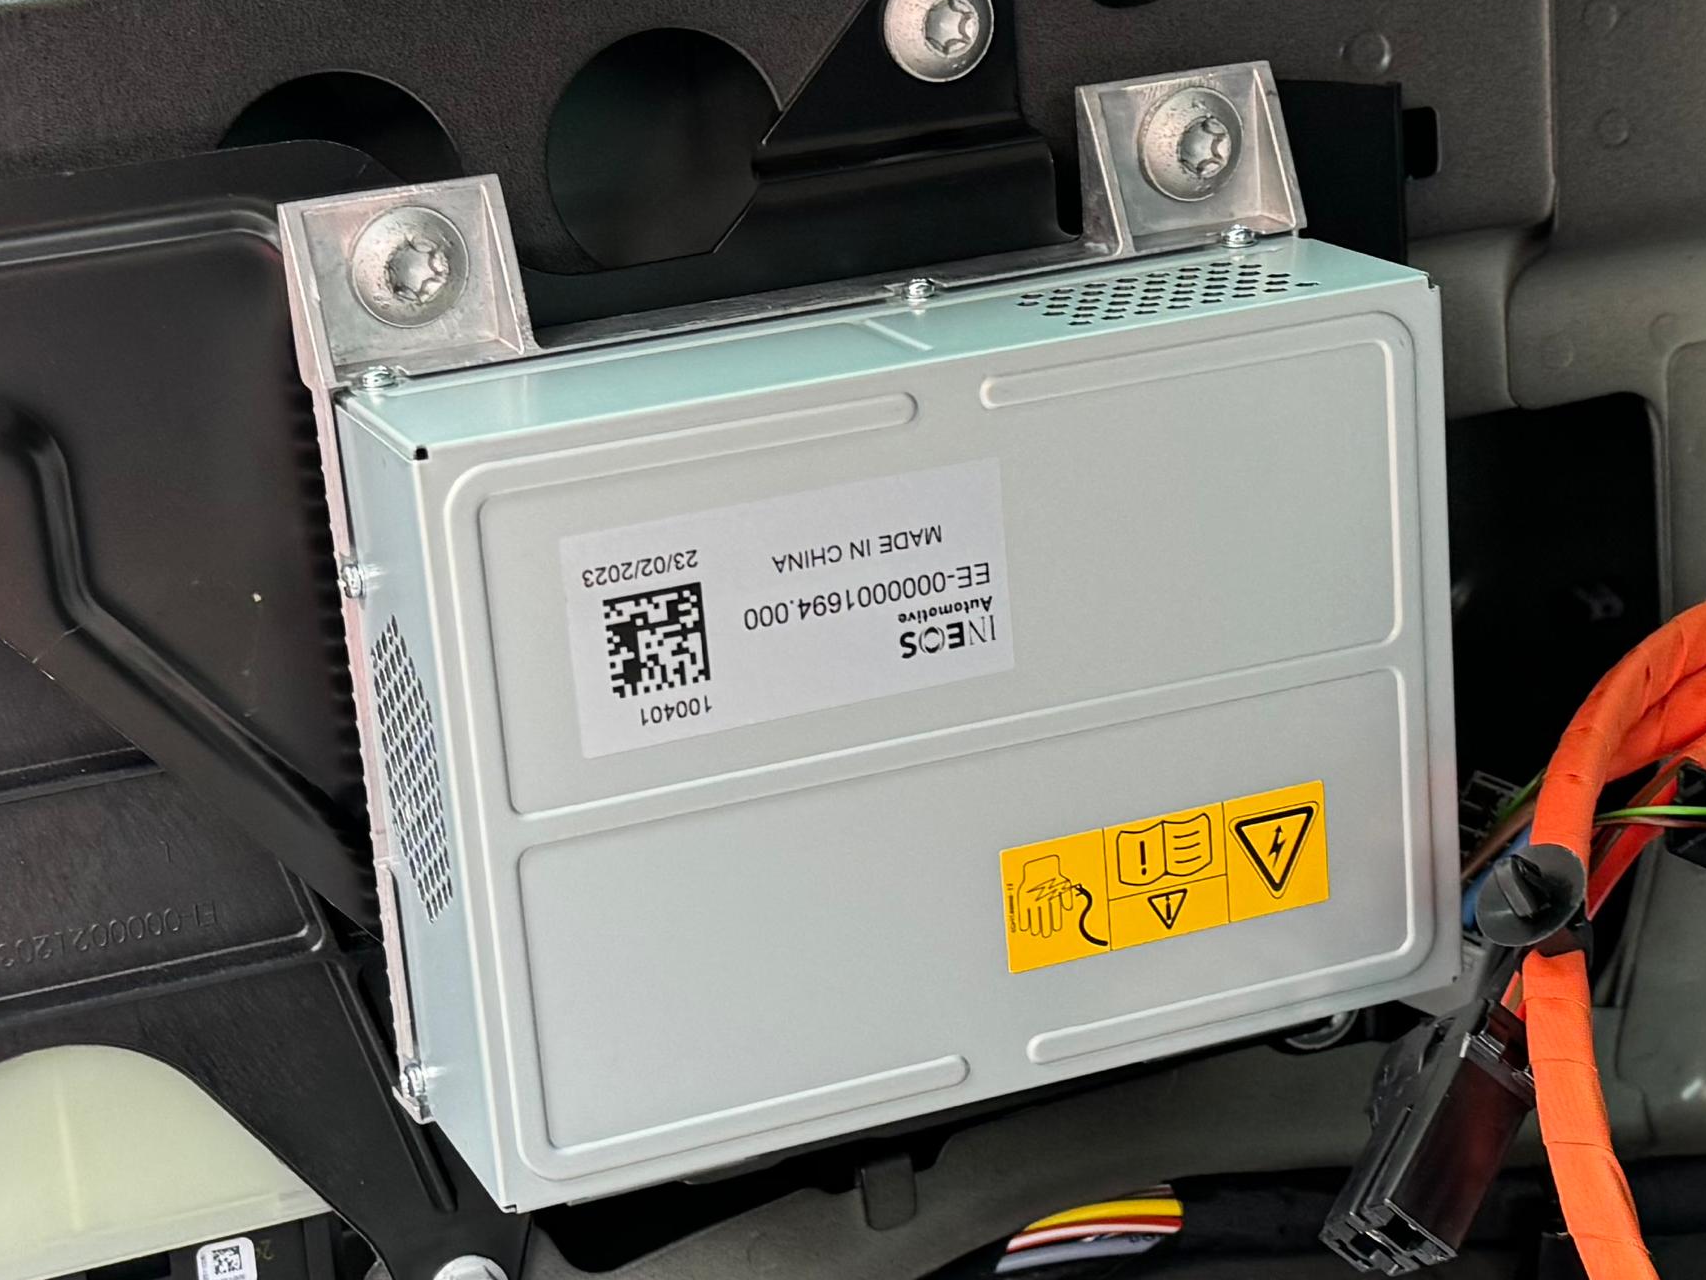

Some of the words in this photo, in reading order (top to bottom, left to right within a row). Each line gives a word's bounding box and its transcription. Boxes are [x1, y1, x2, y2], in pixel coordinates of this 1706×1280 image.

[849, 538, 870, 562] IN
[879, 524, 942, 554] MADE
[582, 548, 698, 589] 23/02/2023
[772, 544, 842, 574] CHINA
[743, 562, 991, 631] EE-0000001694.000
[897, 595, 993, 626] Automotive
[899, 614, 997, 660] INEOS
[639, 695, 713, 726] 100401
